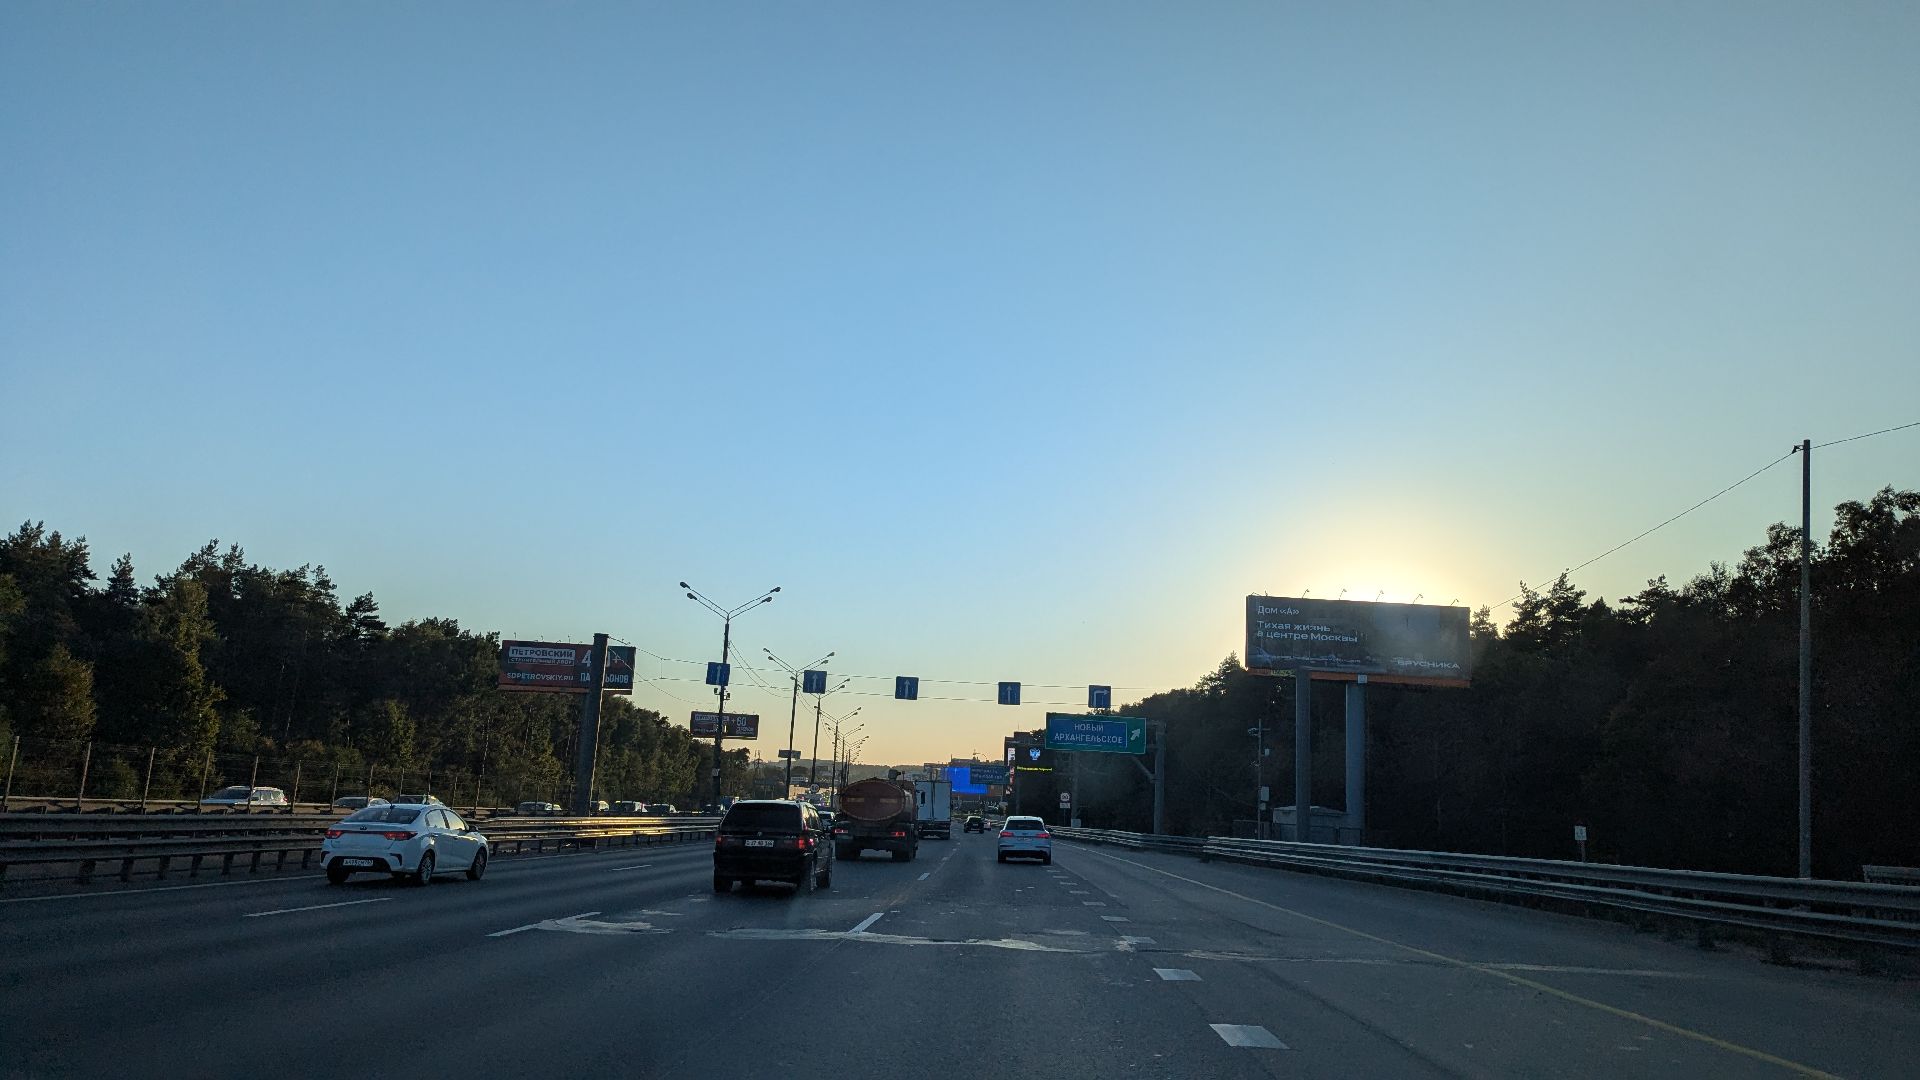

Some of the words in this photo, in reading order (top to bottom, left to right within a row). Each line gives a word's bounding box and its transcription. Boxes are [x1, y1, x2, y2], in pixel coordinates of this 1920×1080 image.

[1257, 605, 1278, 615] Дом
[1257, 620, 1291, 630] Тихая
[1293, 623, 1331, 632] жизнь
[1266, 631, 1309, 640] центре
[1310, 632, 1358, 642] Москвы
[511, 648, 573, 658] ПЕТРОВСКИЙ
[1397, 660, 1461, 670] БРУСНИКА
[506, 672, 574, 682] SDPETROVSKIY.RU
[1074, 723, 1104, 732] НОВЫЙ
[1054, 733, 1123, 744] АРХАНГЕЛЬСКОЕ
